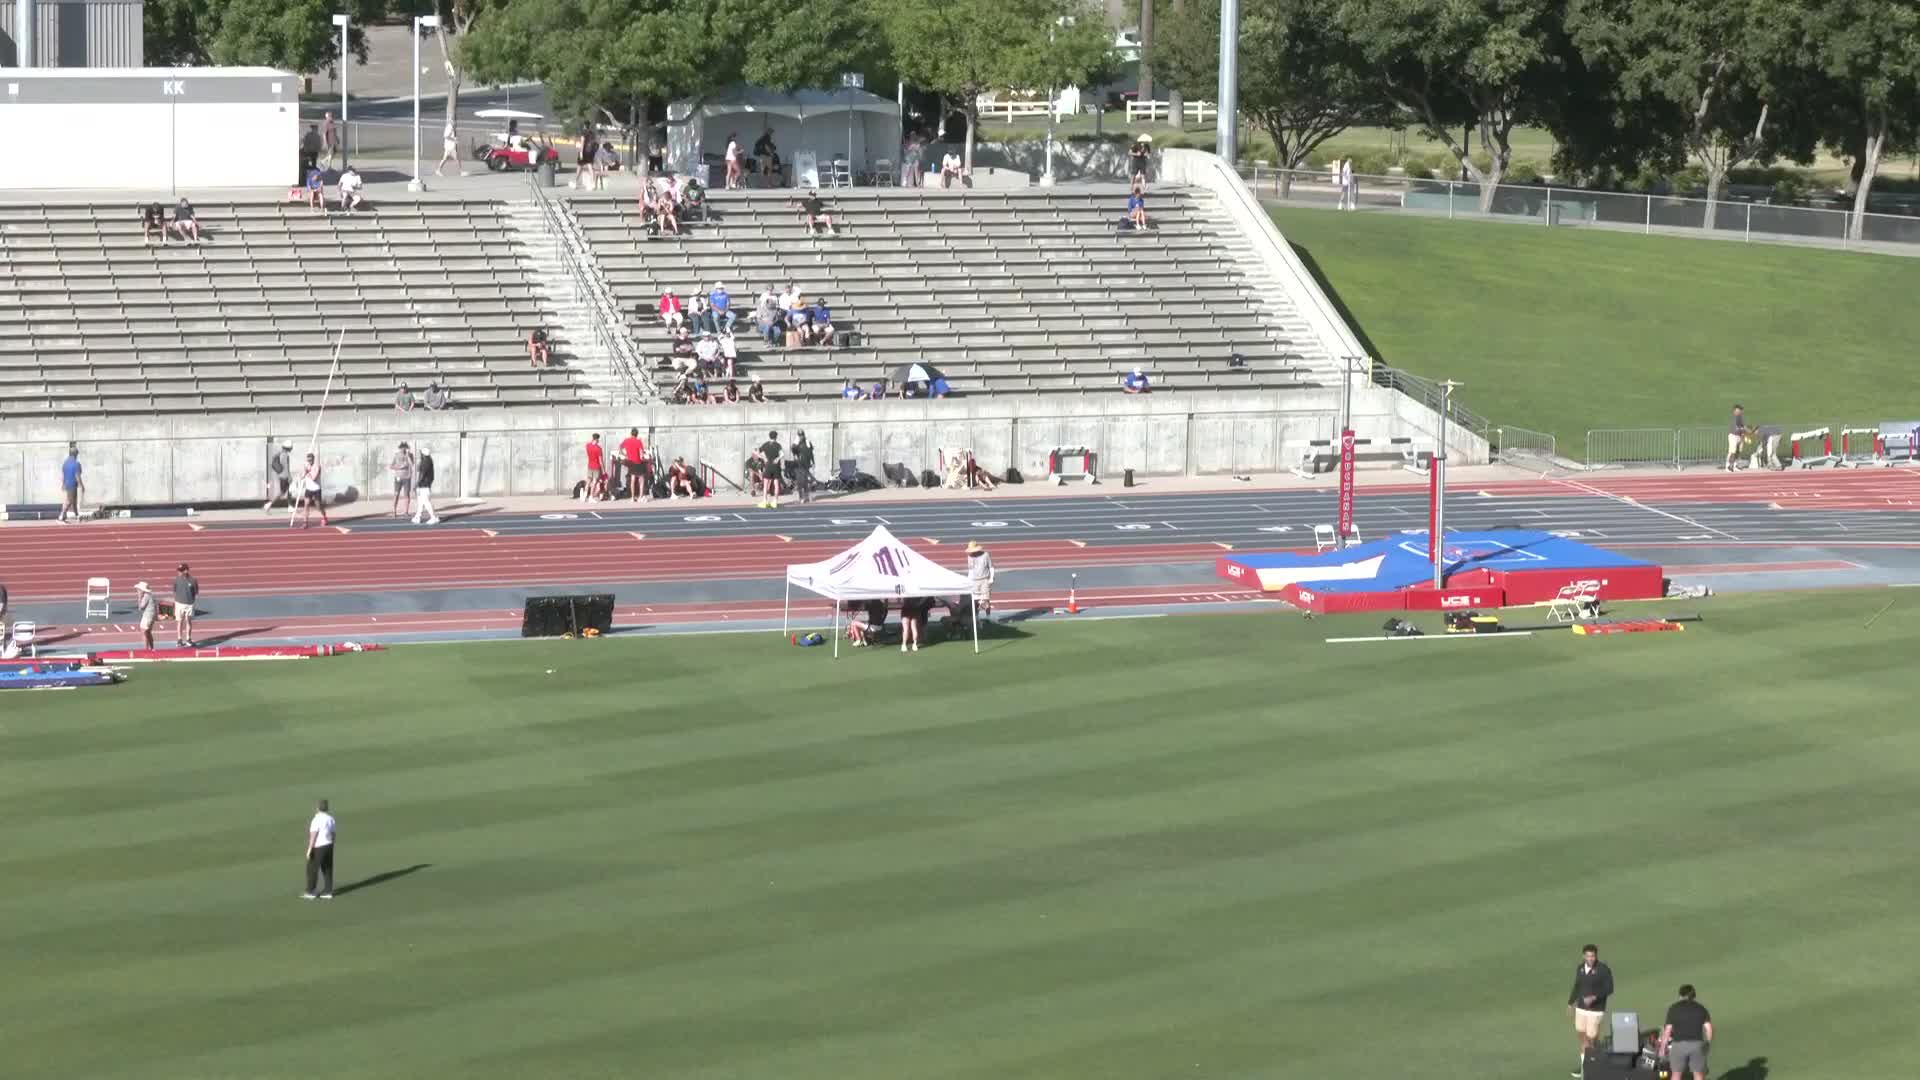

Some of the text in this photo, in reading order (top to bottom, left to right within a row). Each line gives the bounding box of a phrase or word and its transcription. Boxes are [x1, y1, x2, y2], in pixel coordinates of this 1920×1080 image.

[163, 80, 185, 95] KK
[1342, 451, 1352, 532] BUCHANAN
[1441, 596, 1470, 607] UCS
